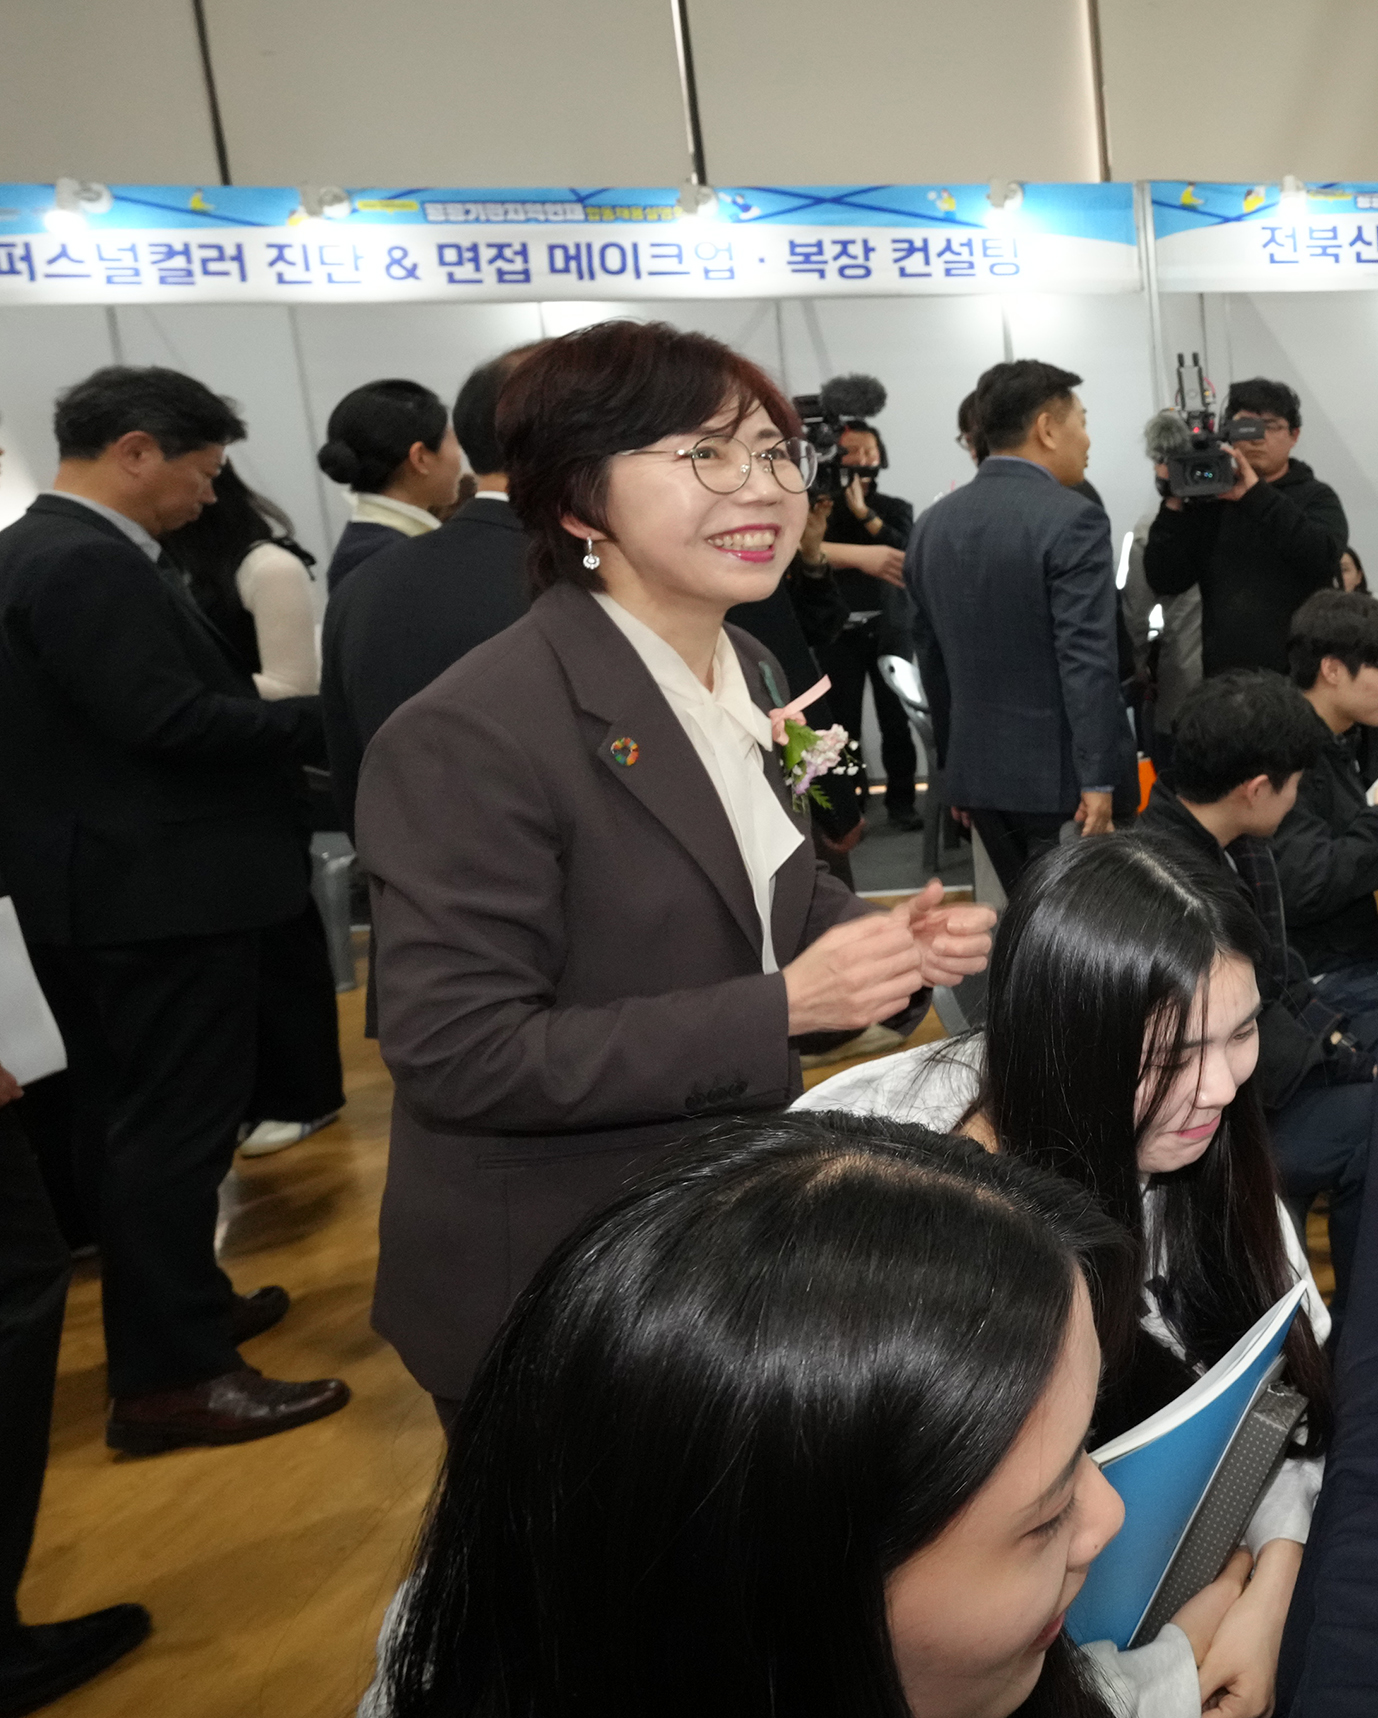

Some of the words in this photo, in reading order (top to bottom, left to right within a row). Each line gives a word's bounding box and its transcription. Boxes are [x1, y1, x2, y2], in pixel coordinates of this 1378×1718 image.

[0, 242, 248, 286] 퍼스널컬러
[266, 241, 364, 285] 진단
[385, 245, 422, 281] &
[437, 241, 531, 285] 면접
[548, 240, 736, 283] 메이크업
[787, 238, 875, 280] 복장
[891, 236, 1022, 279] 컨설팅
